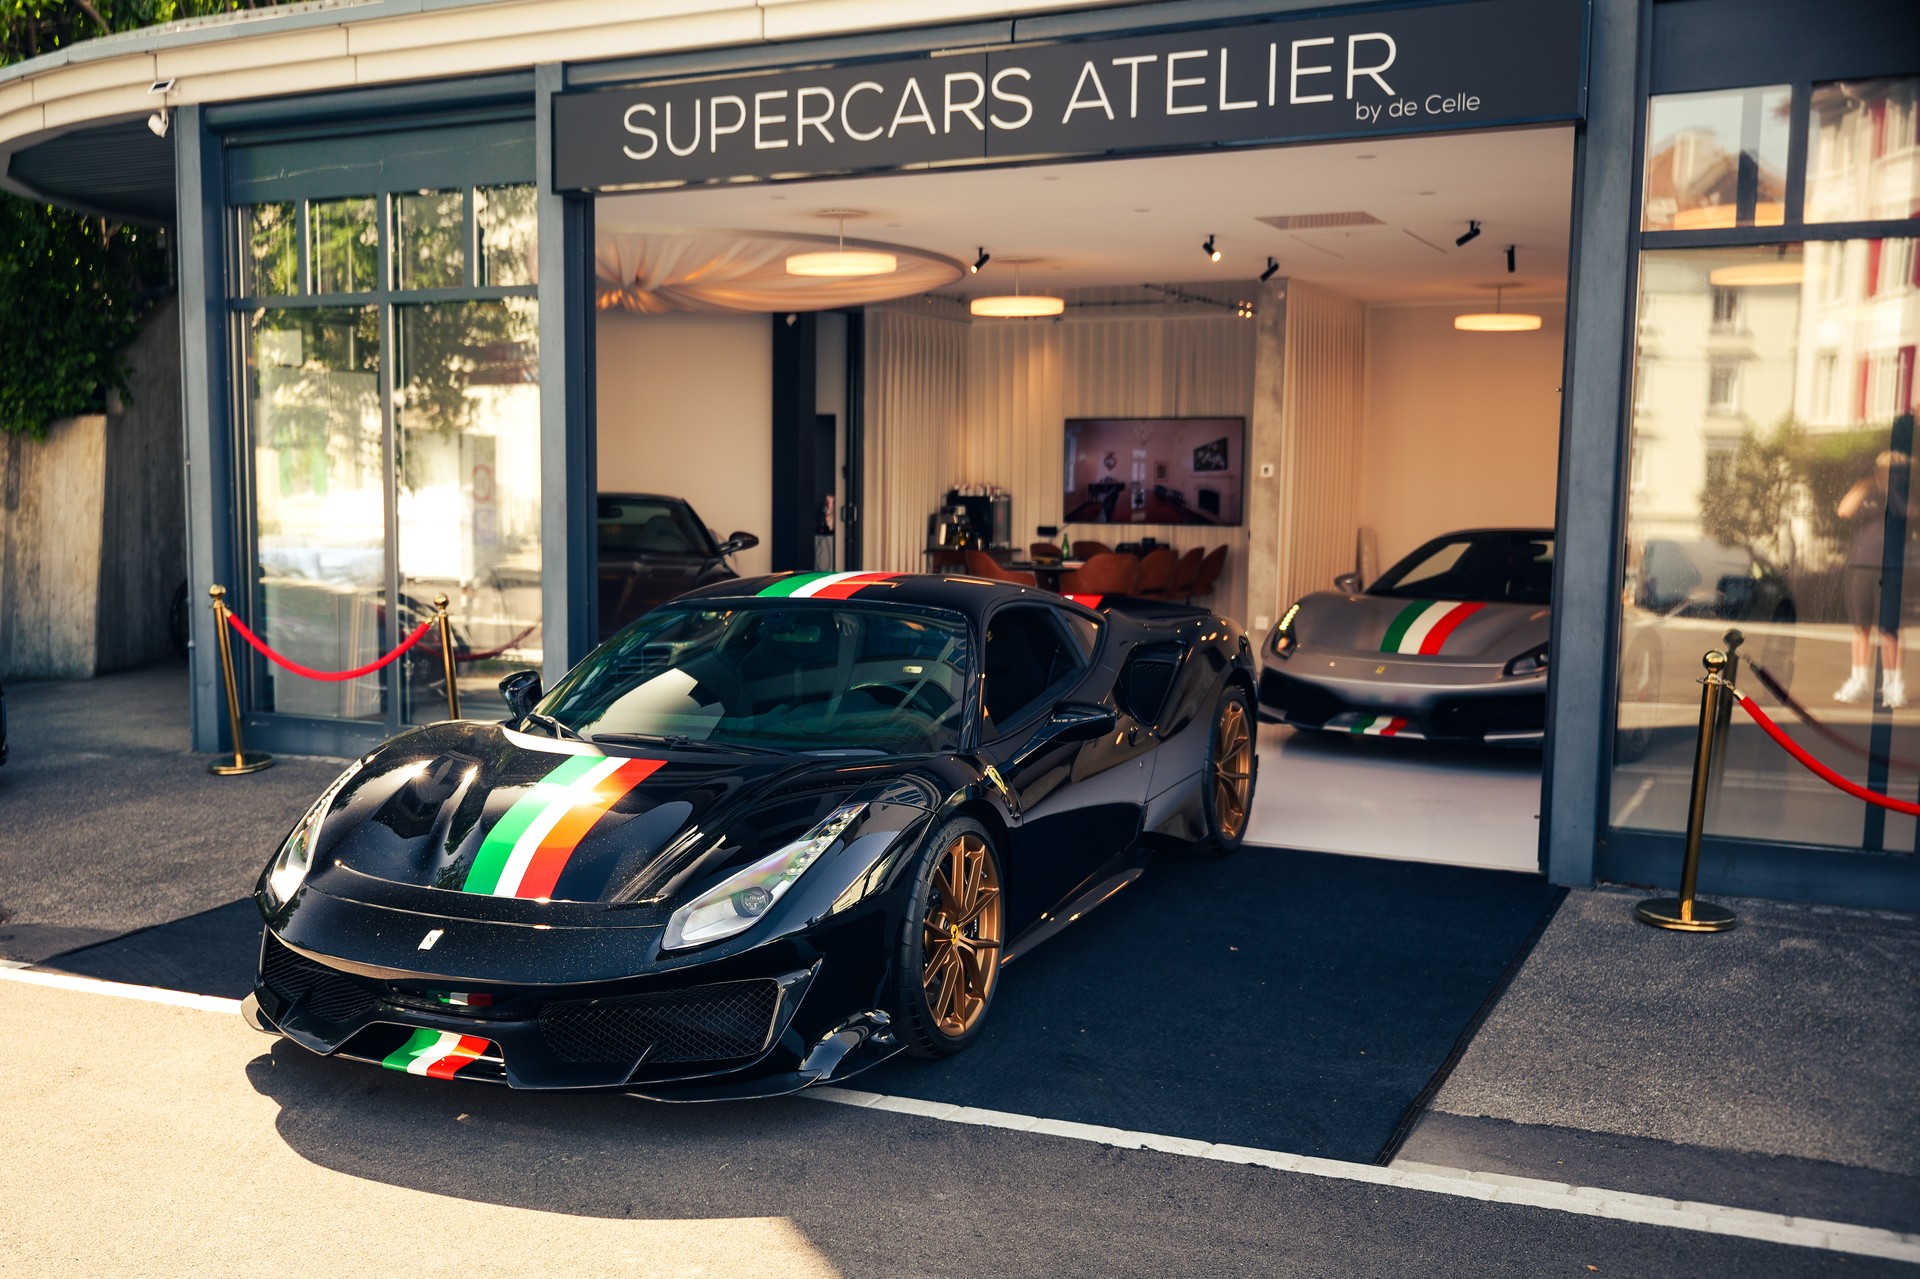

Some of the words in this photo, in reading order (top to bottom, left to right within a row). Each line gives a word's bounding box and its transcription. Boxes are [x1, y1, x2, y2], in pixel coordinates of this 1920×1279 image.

[622, 66, 1034, 161] SUPERCARS
[1061, 32, 1397, 125] ATELIER
[1355, 101, 1382, 124] by
[1388, 97, 1418, 118] de
[1425, 92, 1481, 115] Celle
